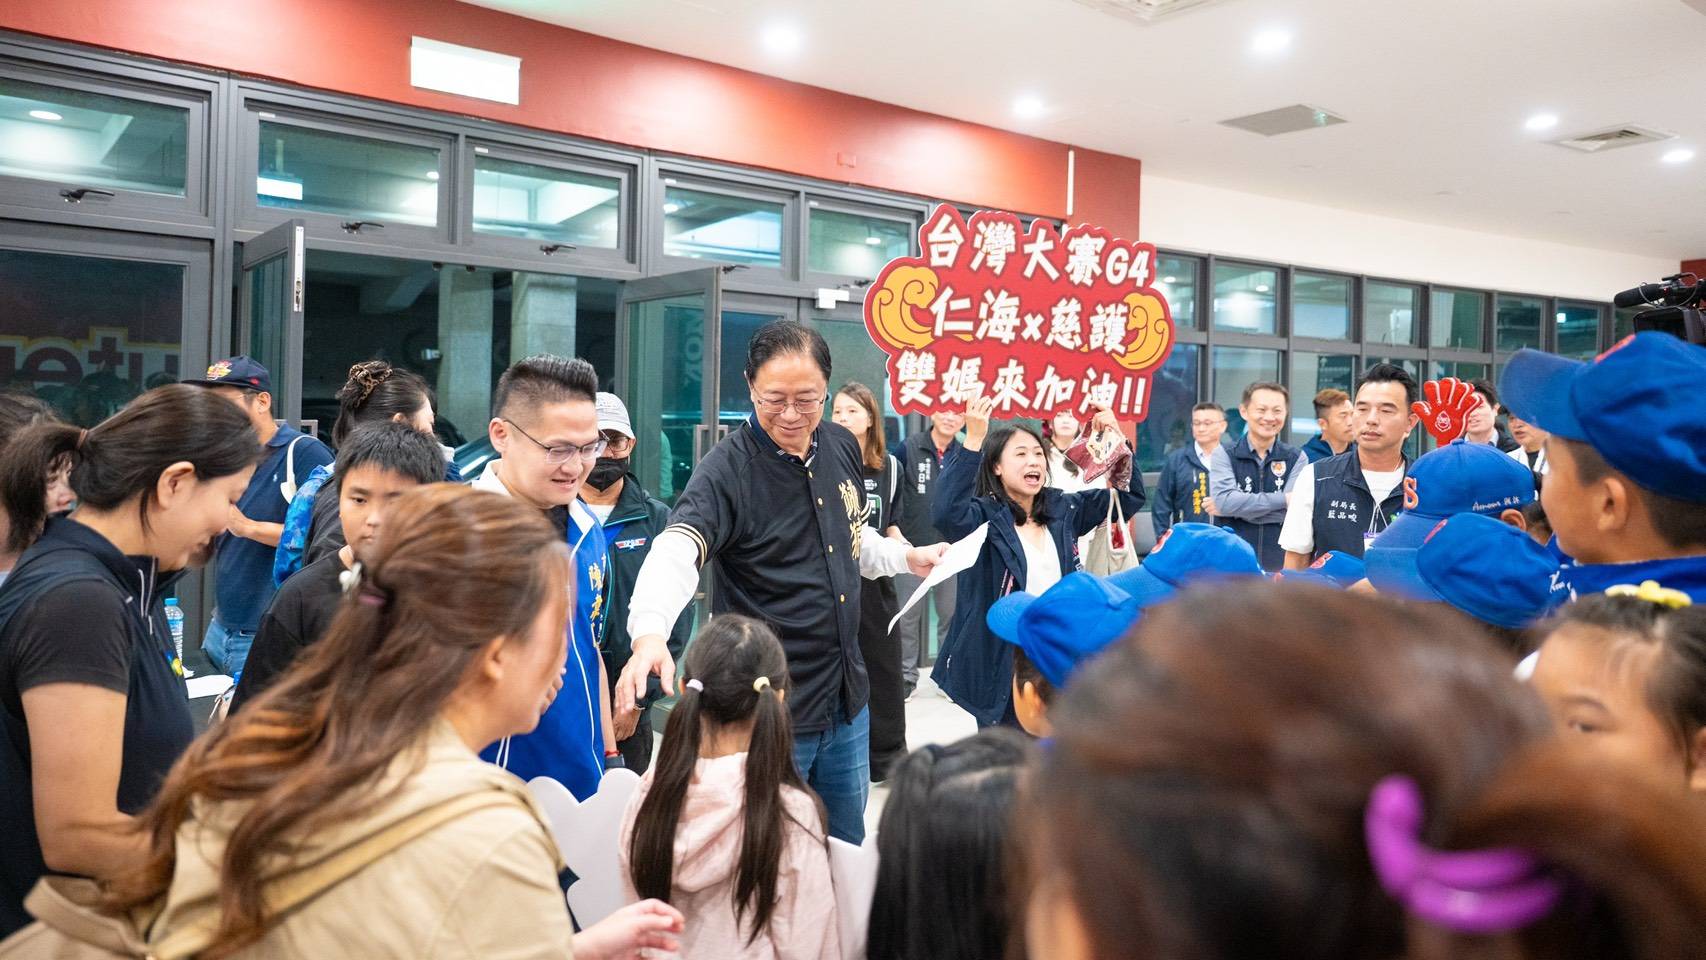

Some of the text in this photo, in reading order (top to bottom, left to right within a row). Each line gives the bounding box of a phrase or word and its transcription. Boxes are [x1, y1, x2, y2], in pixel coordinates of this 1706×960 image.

[927, 213, 1149, 287] 台灣大賽G4
[895, 350, 1146, 415] 雙媽來加油!!
